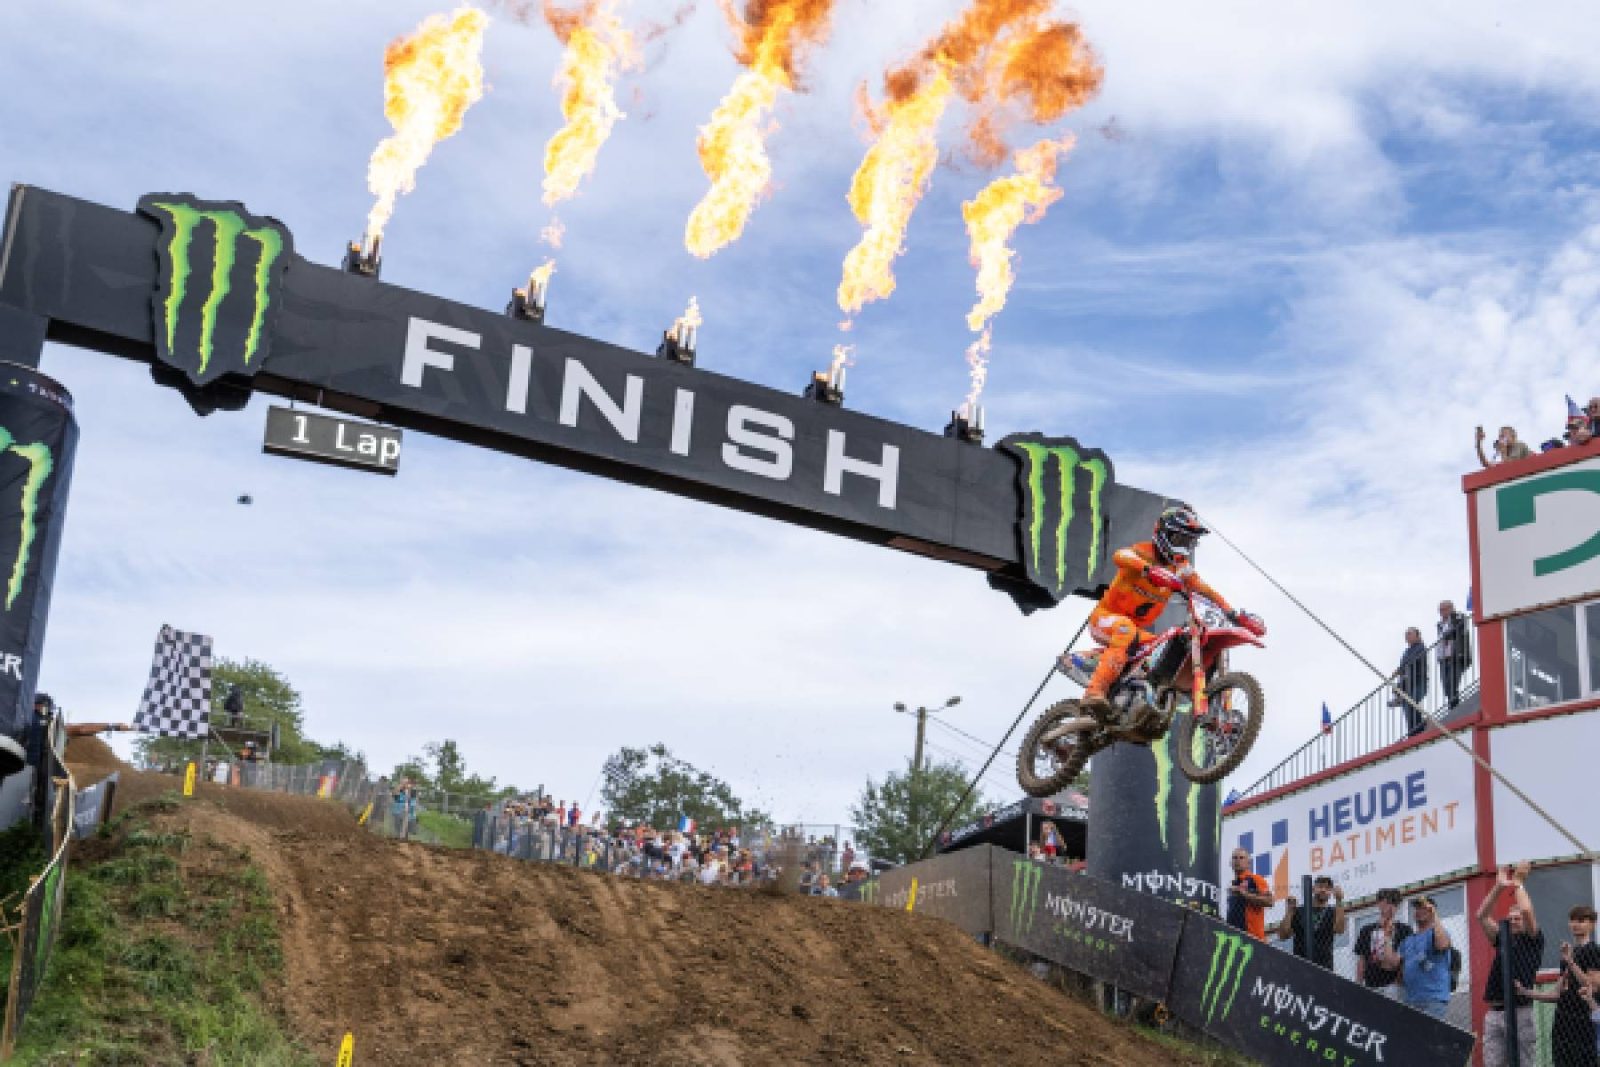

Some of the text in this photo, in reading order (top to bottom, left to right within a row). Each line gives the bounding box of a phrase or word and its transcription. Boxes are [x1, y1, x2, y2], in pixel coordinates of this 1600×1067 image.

[292, 415, 401, 465] 1 Lap
[400, 316, 900, 510] FINISH
[1309, 770, 1427, 842] HEUDE
[1310, 801, 1459, 872] BATIMENT
[1045, 890, 1134, 942] MONSTER
[1122, 869, 1220, 902] MONSTE
[1250, 976, 1387, 1062] MONSTER
